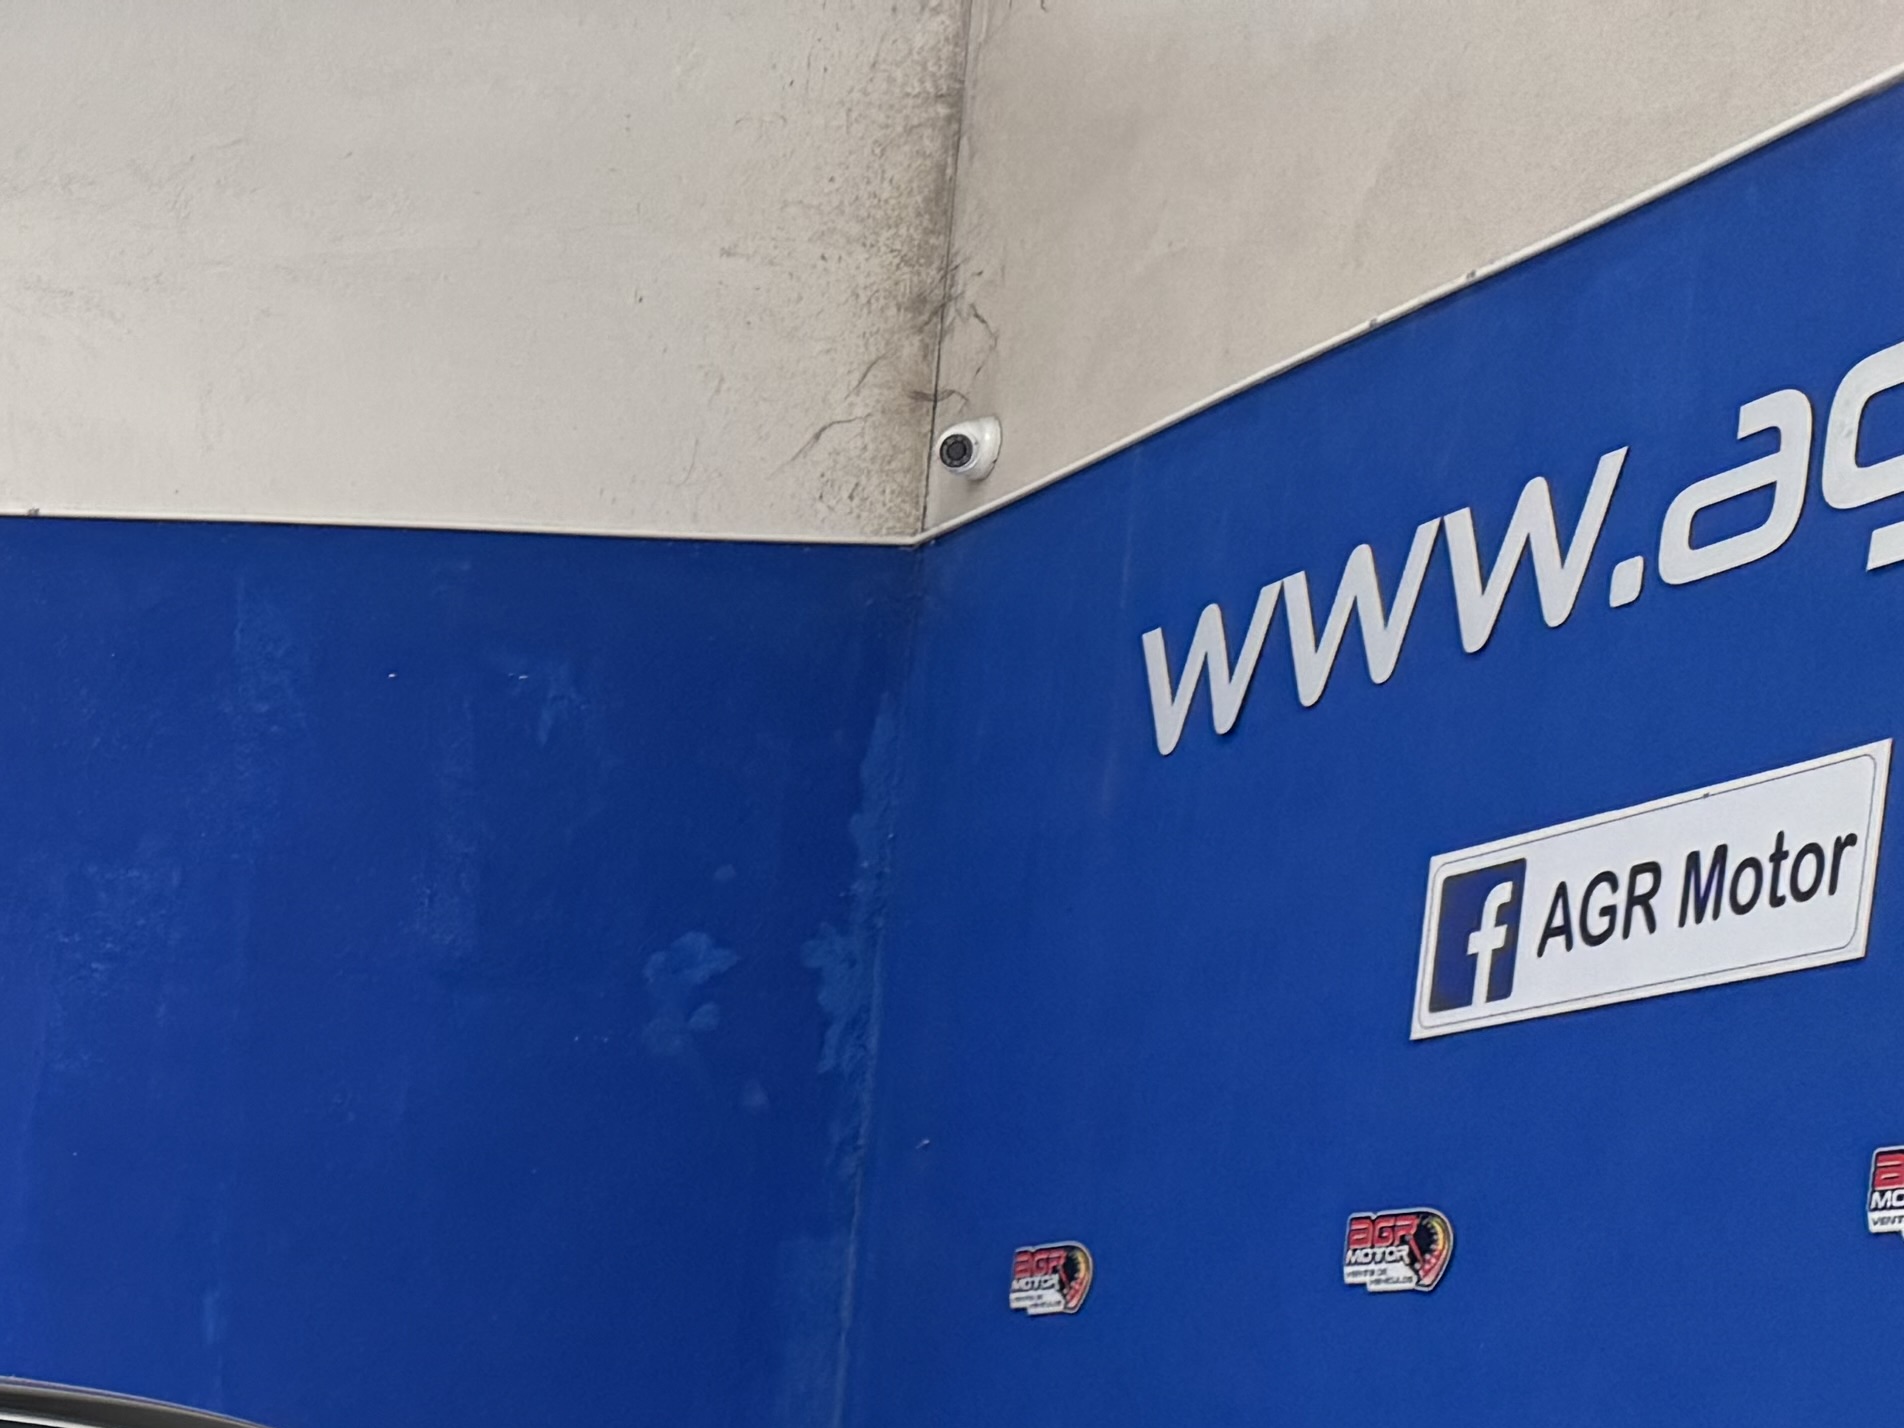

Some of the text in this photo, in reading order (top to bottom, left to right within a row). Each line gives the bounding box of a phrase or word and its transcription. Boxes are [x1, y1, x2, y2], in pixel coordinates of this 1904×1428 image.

[1537, 860, 1662, 958] AGR
[1678, 830, 1858, 929] Motor
[1346, 1245, 1410, 1264] MOTOR
